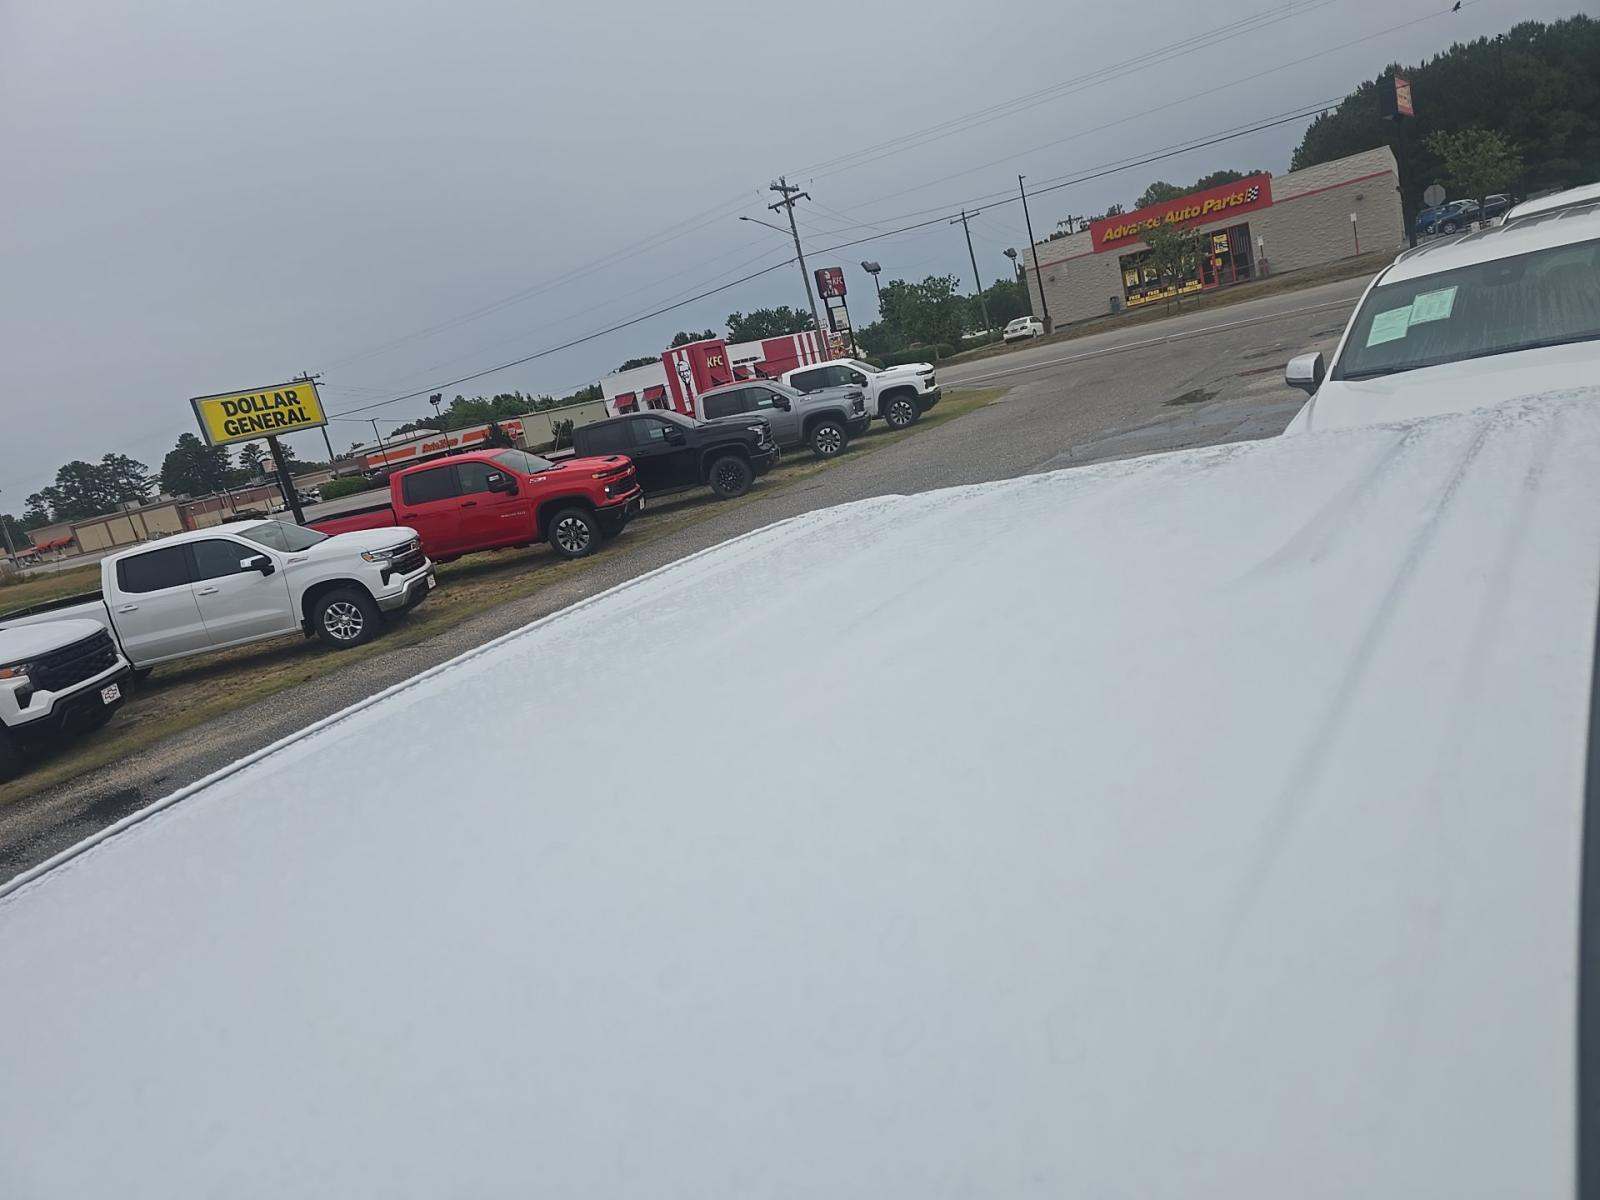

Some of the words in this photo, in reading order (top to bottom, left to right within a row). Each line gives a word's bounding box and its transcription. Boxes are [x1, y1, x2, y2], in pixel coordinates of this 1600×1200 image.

[1165, 204, 1200, 224] Auto
[1202, 192, 1243, 215] Parts
[706, 354, 724, 368] KFC
[221, 390, 301, 418] DOLLAR
[224, 406, 311, 436] GENERAL
